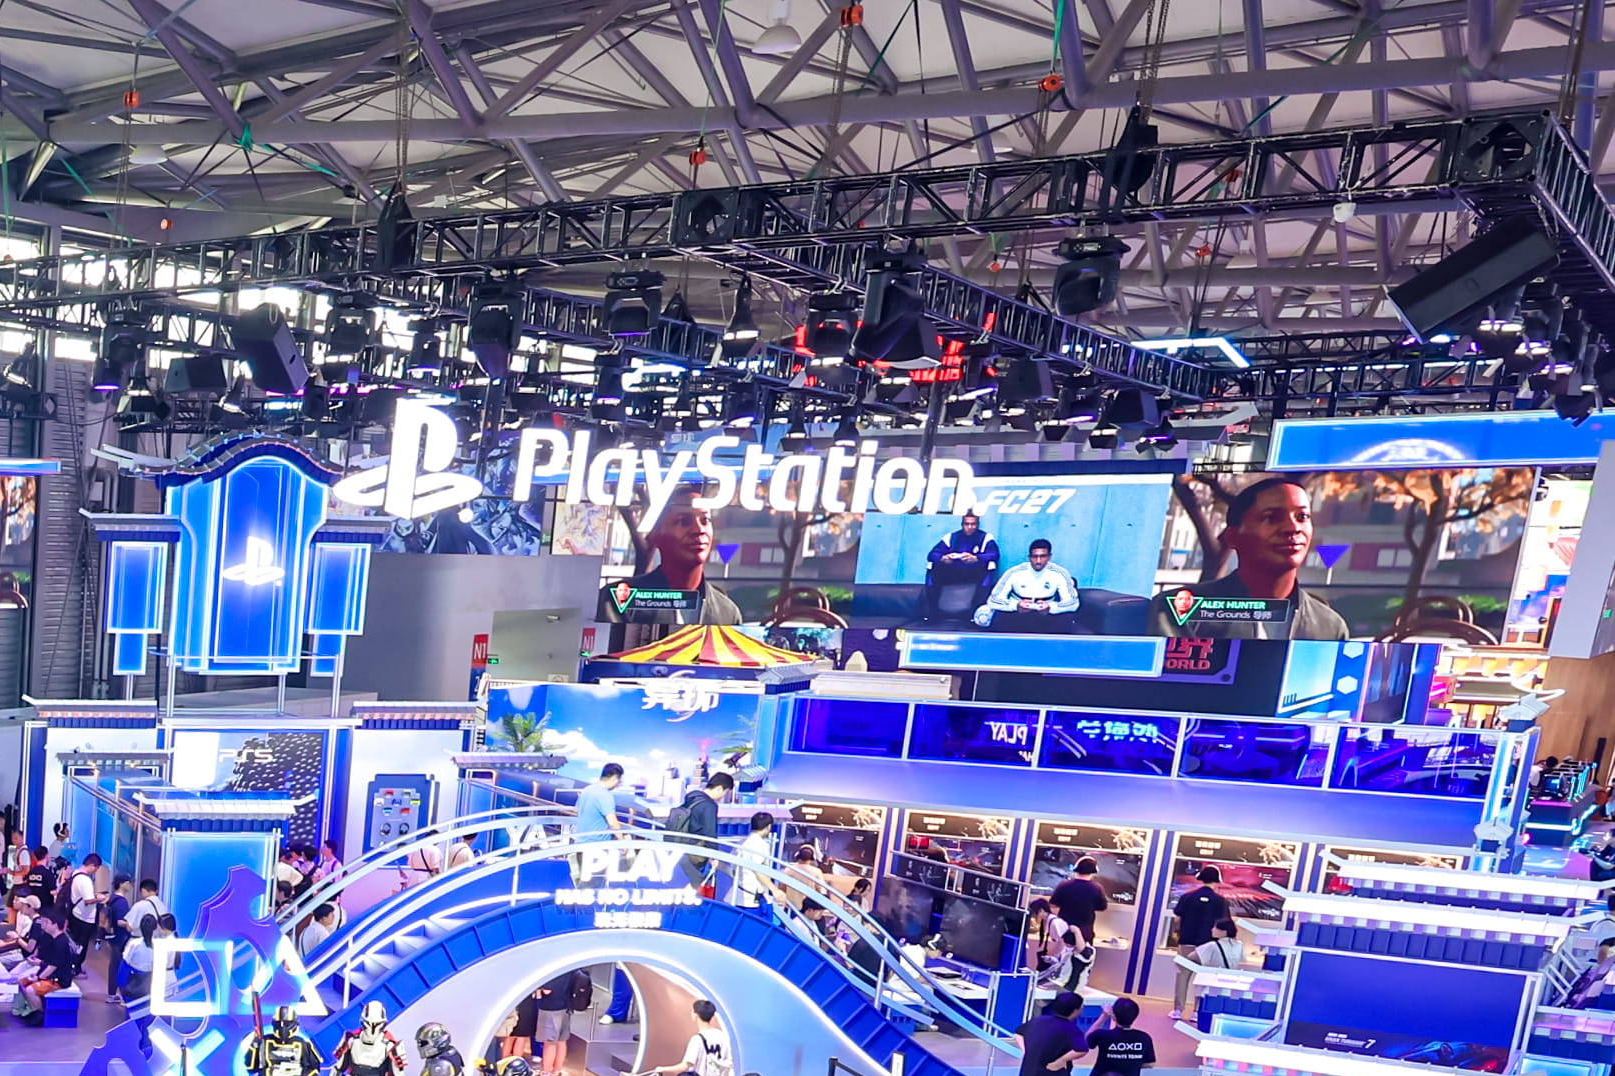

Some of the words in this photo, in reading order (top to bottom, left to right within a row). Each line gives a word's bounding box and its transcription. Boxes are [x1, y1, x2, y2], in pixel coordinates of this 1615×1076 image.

[512, 427, 977, 533] PlayStation
[973, 489, 1077, 514] FC27
[635, 591, 652, 599] ALEX
[1200, 601, 1225, 609] ALEX
[1200, 610, 1214, 618] The
[1216, 611, 1250, 619] Grounds
[218, 749, 274, 763] PS5
[1365, 1039, 1376, 1049] 7
